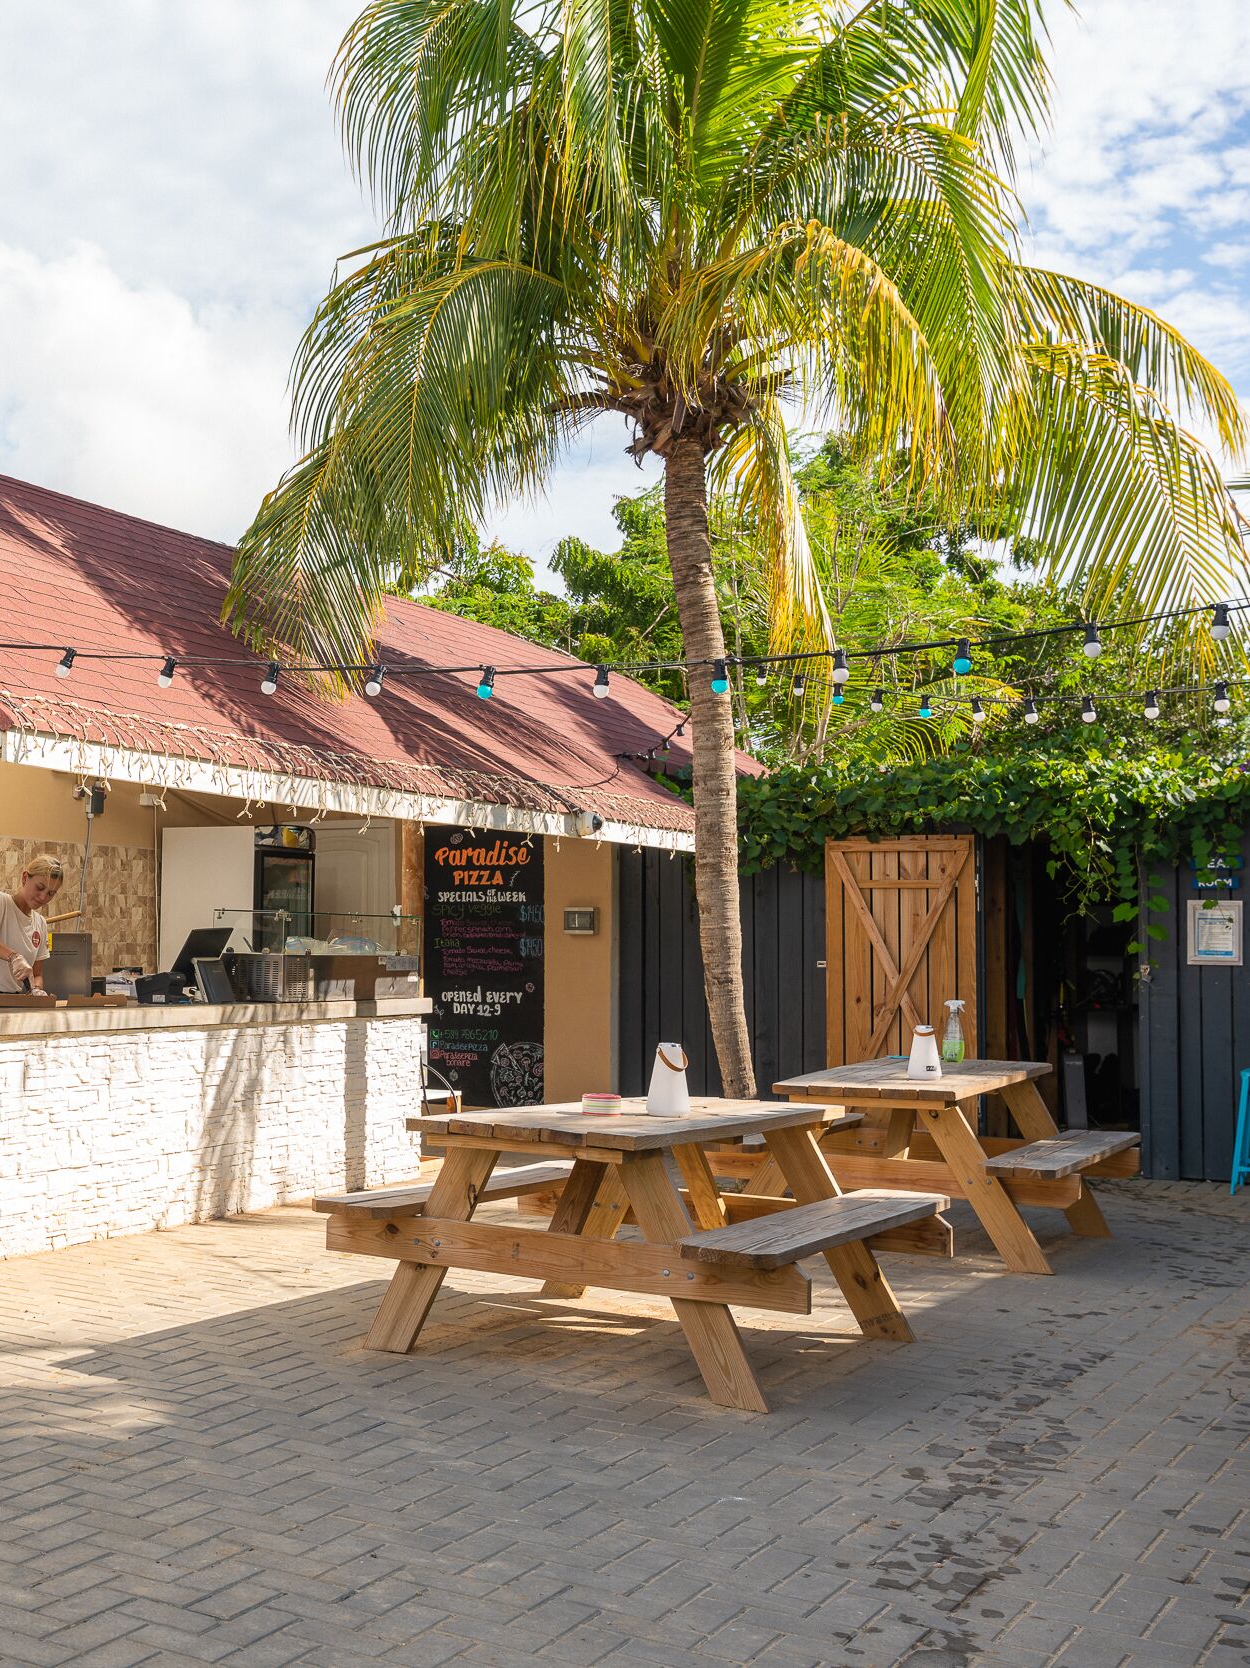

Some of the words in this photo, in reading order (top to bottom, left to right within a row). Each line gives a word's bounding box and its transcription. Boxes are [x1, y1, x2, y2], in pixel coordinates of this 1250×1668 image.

[434, 840, 531, 866] Paradise
[453, 870, 504, 886] PIZZA
[438, 891, 485, 902] SPECIALS
[498, 891, 526, 902] WEEK
[453, 1003, 476, 1015] DAY
[476, 1004, 501, 1017] 12-9
